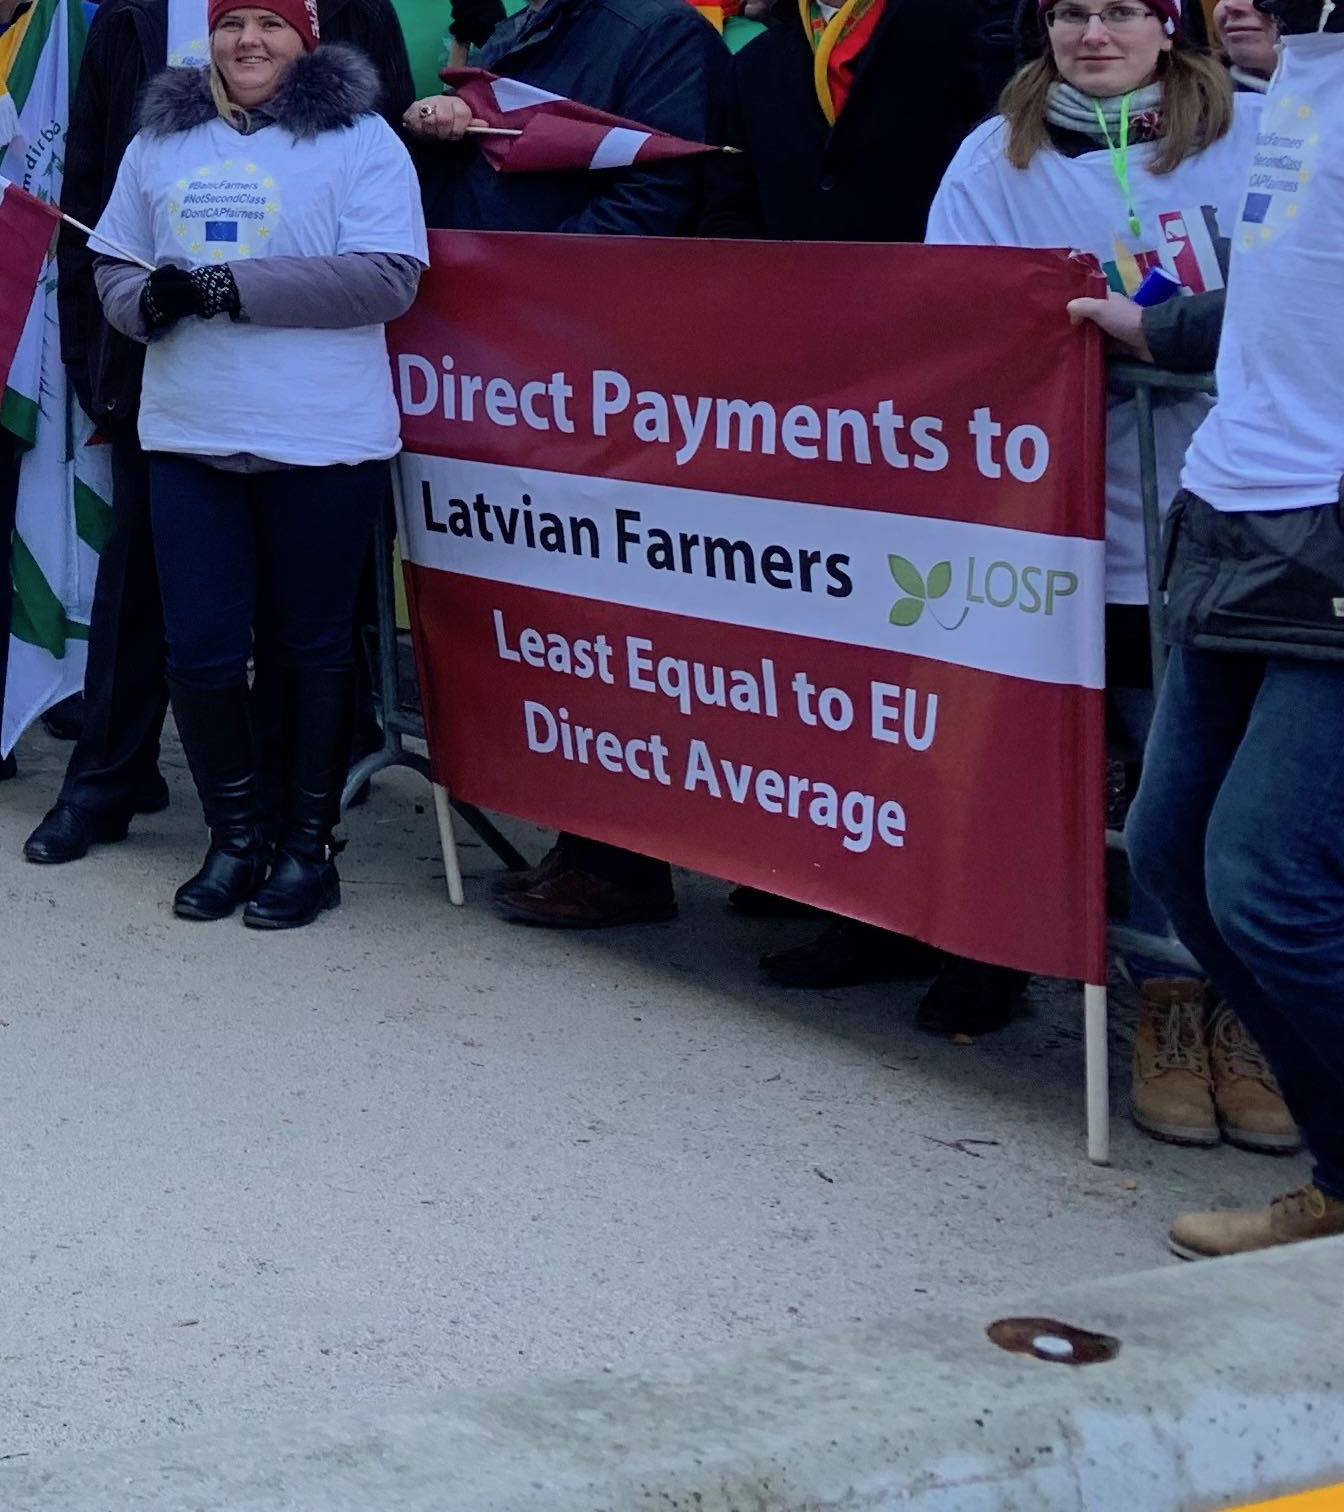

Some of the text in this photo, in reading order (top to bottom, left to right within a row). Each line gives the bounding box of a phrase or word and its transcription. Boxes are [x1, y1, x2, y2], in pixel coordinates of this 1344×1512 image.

[398, 353, 1050, 484] Direct Payments to
[421, 480, 854, 599] Latvian Farmers
[966, 556, 1079, 616] LOSP
[492, 609, 939, 752] Least Equal to EU
[524, 700, 907, 854] Direct Average
